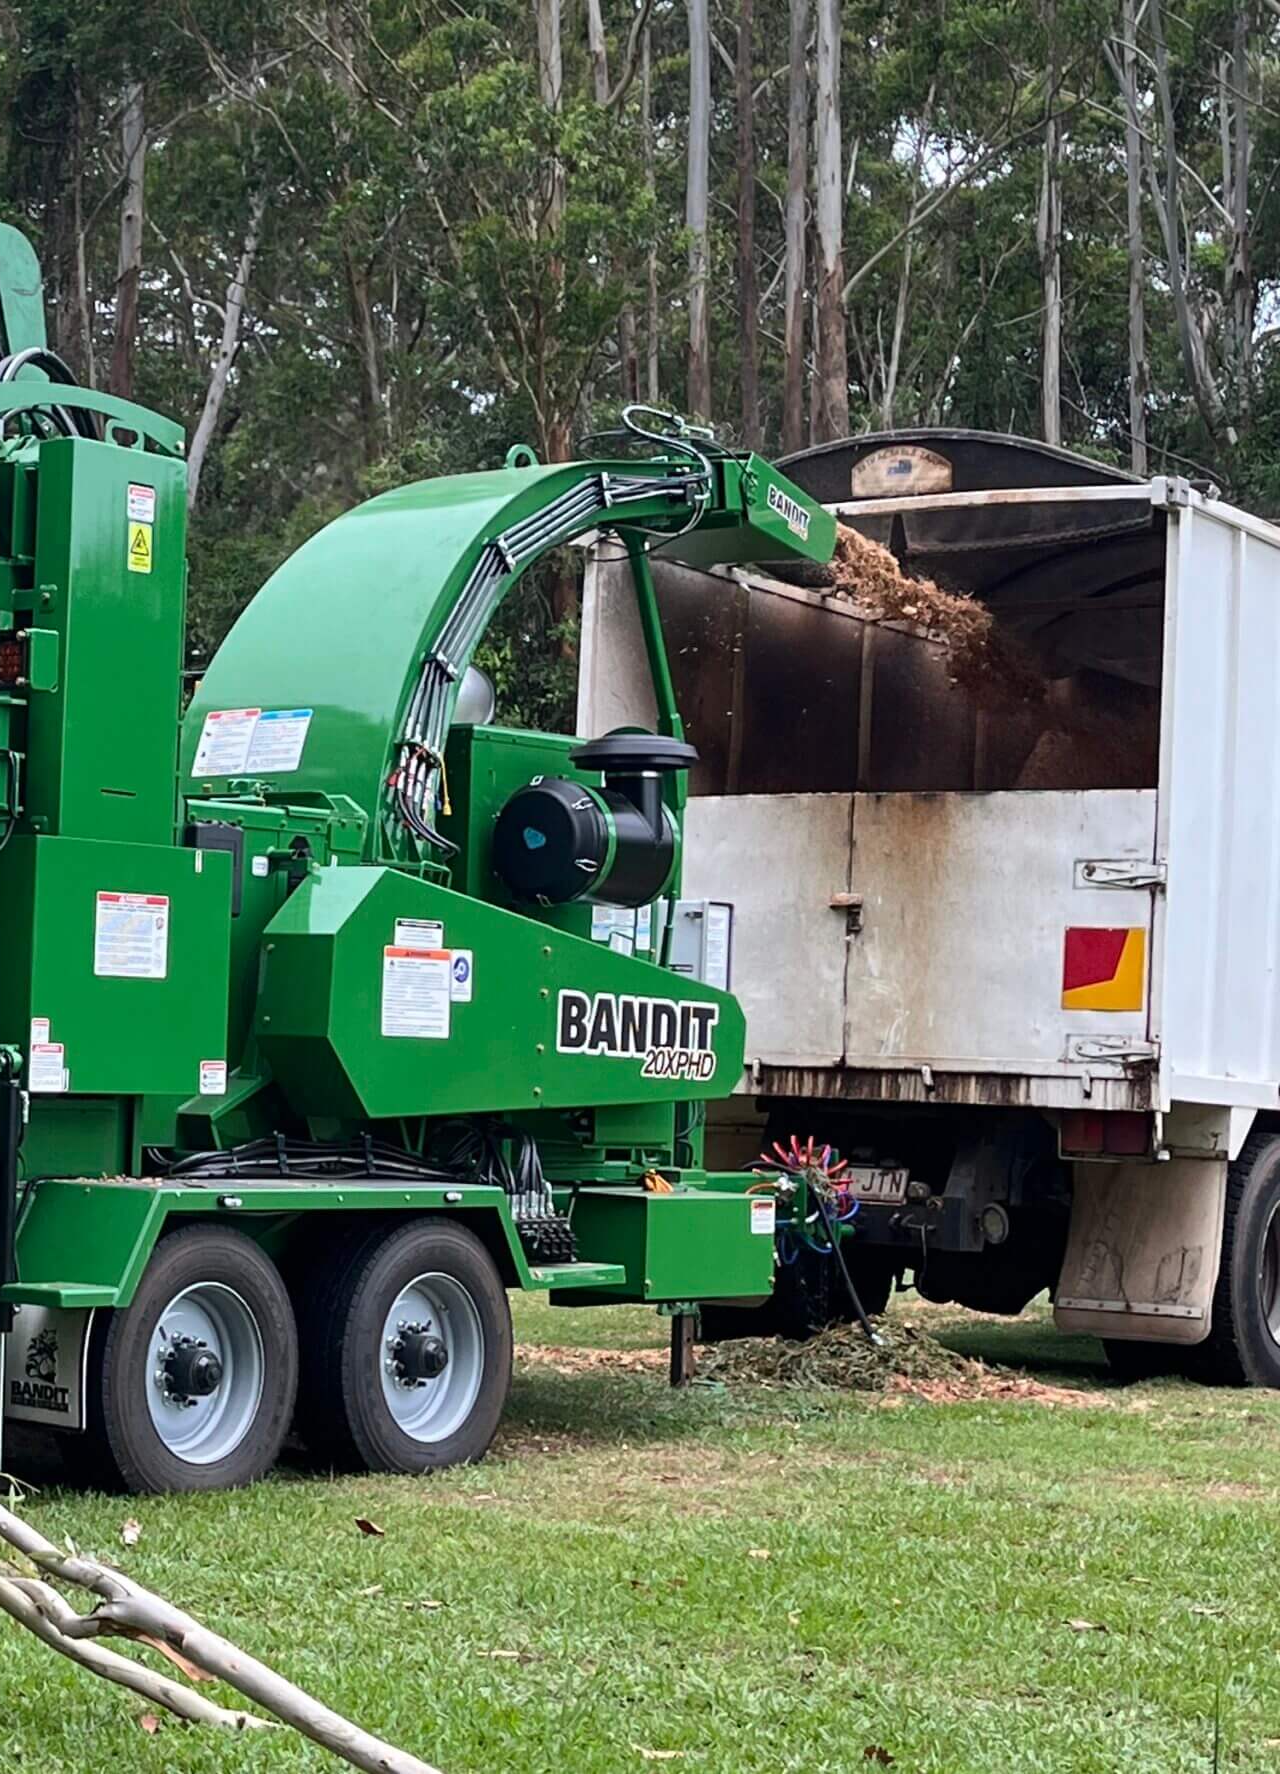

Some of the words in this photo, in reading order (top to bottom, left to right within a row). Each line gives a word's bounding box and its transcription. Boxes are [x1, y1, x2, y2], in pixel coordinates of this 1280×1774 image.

[768, 486, 809, 529] BANDIT
[560, 994, 716, 1053] BANDIT
[643, 1049, 715, 1078] 20XPHD
[11, 1380, 70, 1404] BANDIT
